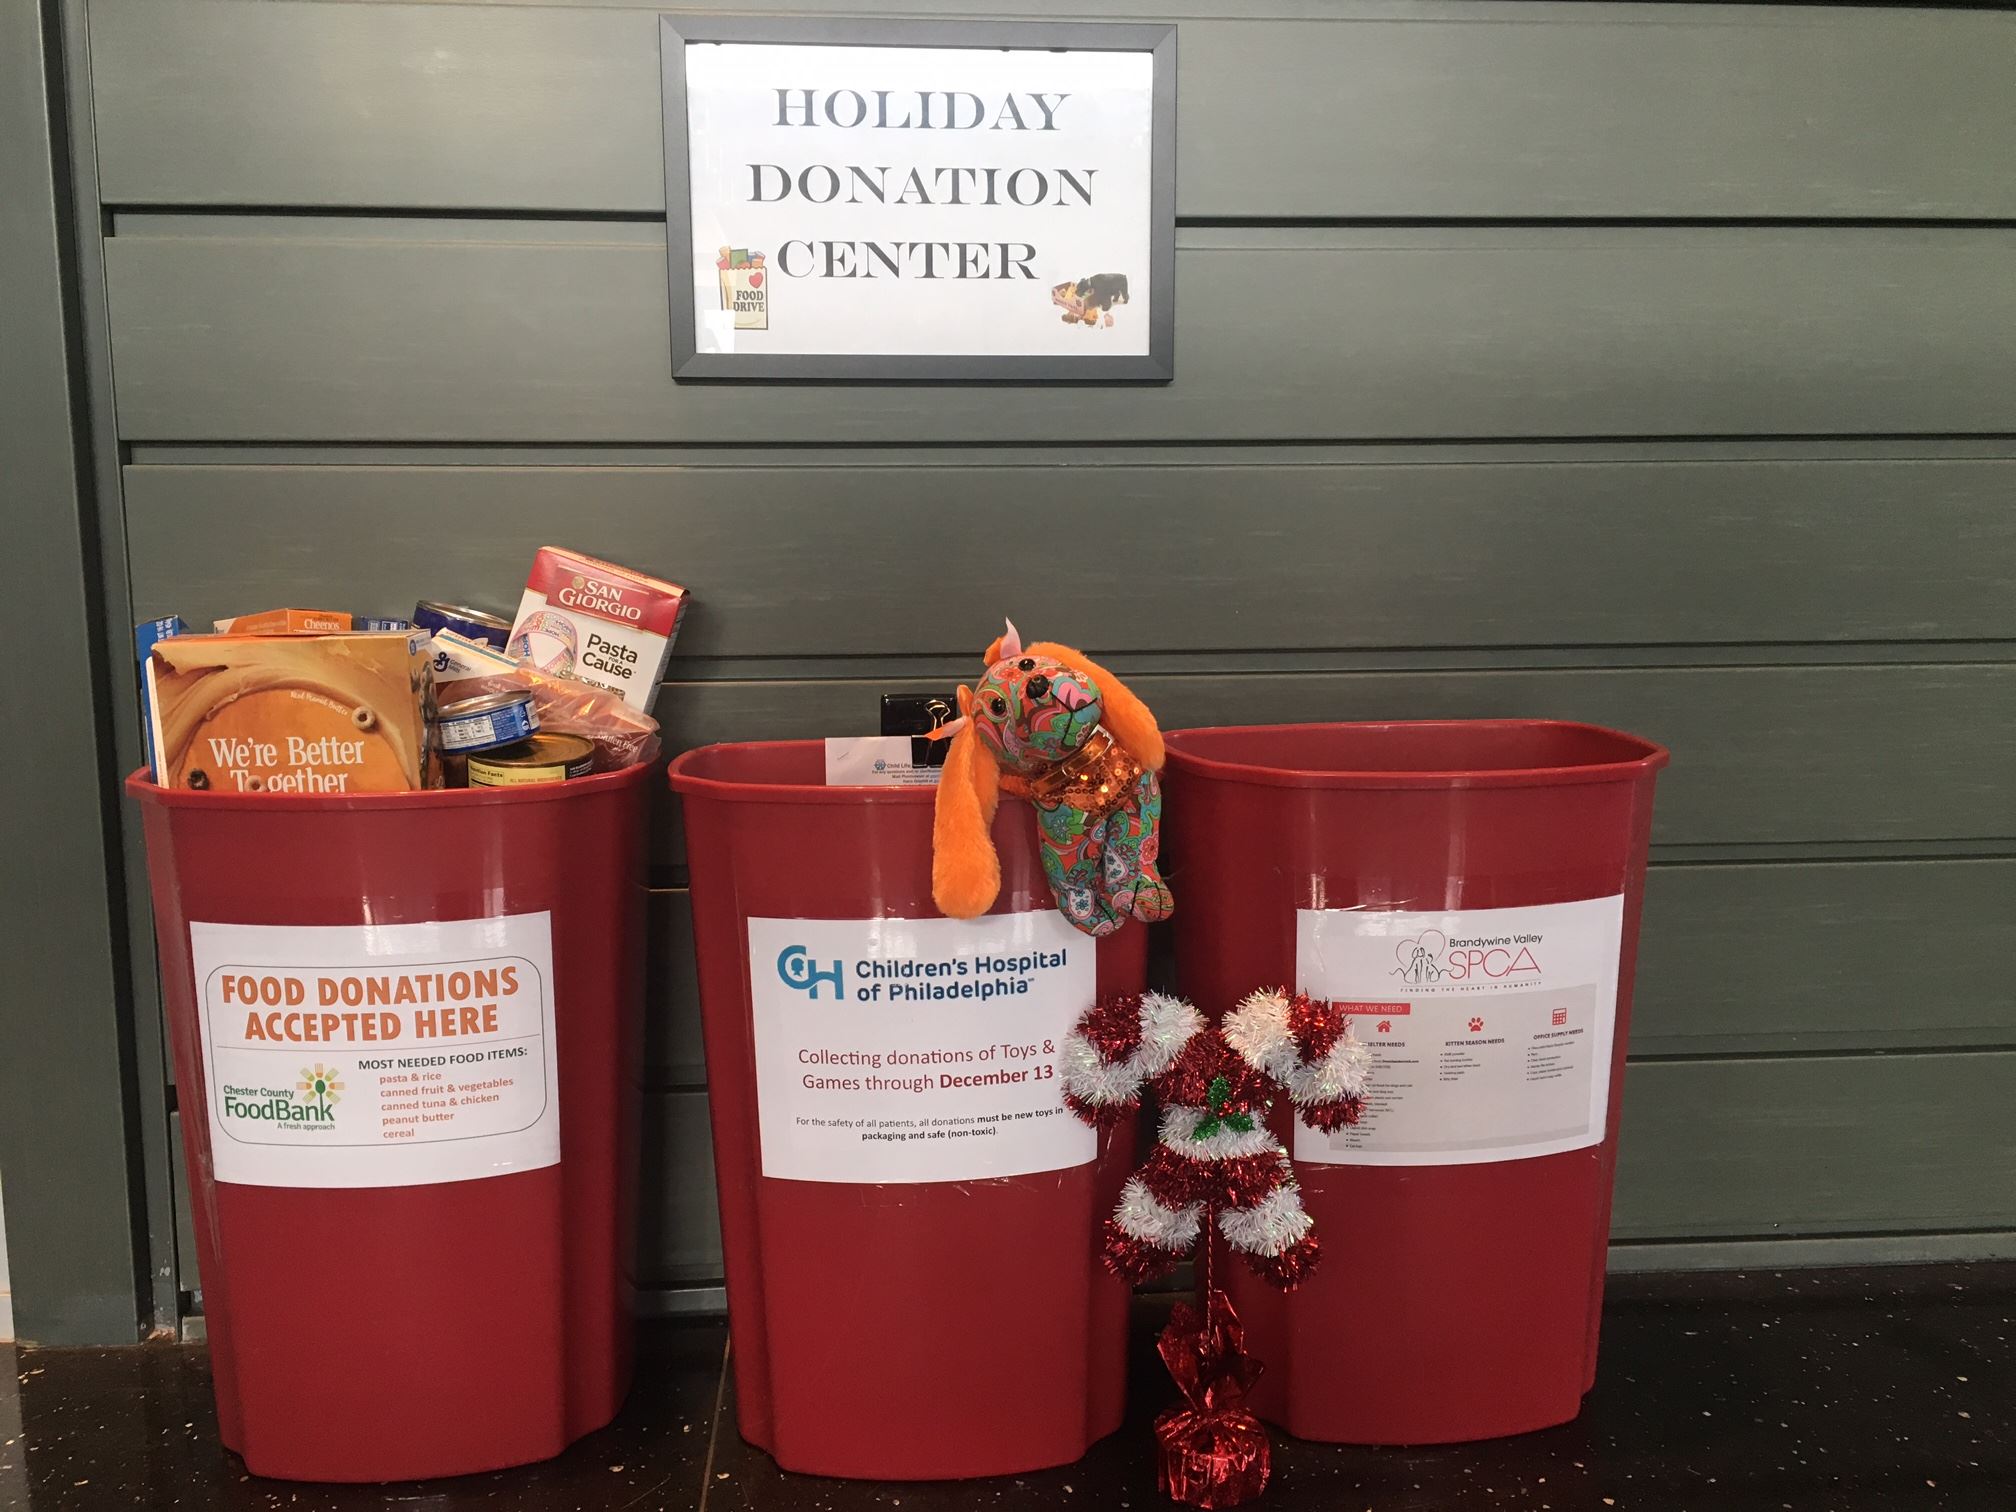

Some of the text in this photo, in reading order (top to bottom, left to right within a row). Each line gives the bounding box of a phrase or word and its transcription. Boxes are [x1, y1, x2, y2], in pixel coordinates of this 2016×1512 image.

[772, 89, 1072, 131] HOLIDAY
[746, 164, 1099, 206] DONATION
[777, 240, 1040, 279] CENTER
[733, 301, 765, 313] DRIVE
[735, 290, 764, 302] FOOD
[585, 581, 623, 601] SAN
[559, 587, 642, 620] GIORGIO
[587, 634, 638, 664] Pasta
[583, 652, 632, 679] Cause
[208, 736, 364, 768] We're Better
[1450, 934, 1543, 948] Brandywine Valley
[856, 949, 1067, 979] Children's Hospital
[1448, 947, 1541, 980] SPCA
[222, 966, 519, 1007] FOOD DONATIONS
[857, 983, 881, 1001] of
[1504, 981, 1542, 989] HUMANITY
[244, 1004, 499, 1042] ACCEPTED HERE
[358, 1047, 528, 1070] MOST NEEDED FOOD ITEMS:
[798, 1039, 1055, 1069] Collecting donations of Toys &
[380, 1072, 442, 1085] pasta & rice
[380, 1077, 514, 1097] canned fruit & vegetables
[803, 1064, 1054, 1093] Games through December 13
[224, 1085, 294, 1100] Chester County
[381, 1093, 499, 1111] canned tuna & chicken
[224, 1096, 335, 1121] FoodBank
[382, 1113, 455, 1126] peanut butter
[796, 1106, 1064, 1130] For the safety of all patients, all donations must be new toys in
[284, 1122, 301, 1130] fresh
[303, 1123, 335, 1132] approach
[383, 1128, 415, 1139] cereal
[862, 1131, 906, 1142] packaging
[908, 1131, 925, 1140] and
[927, 1130, 946, 1138] safe
